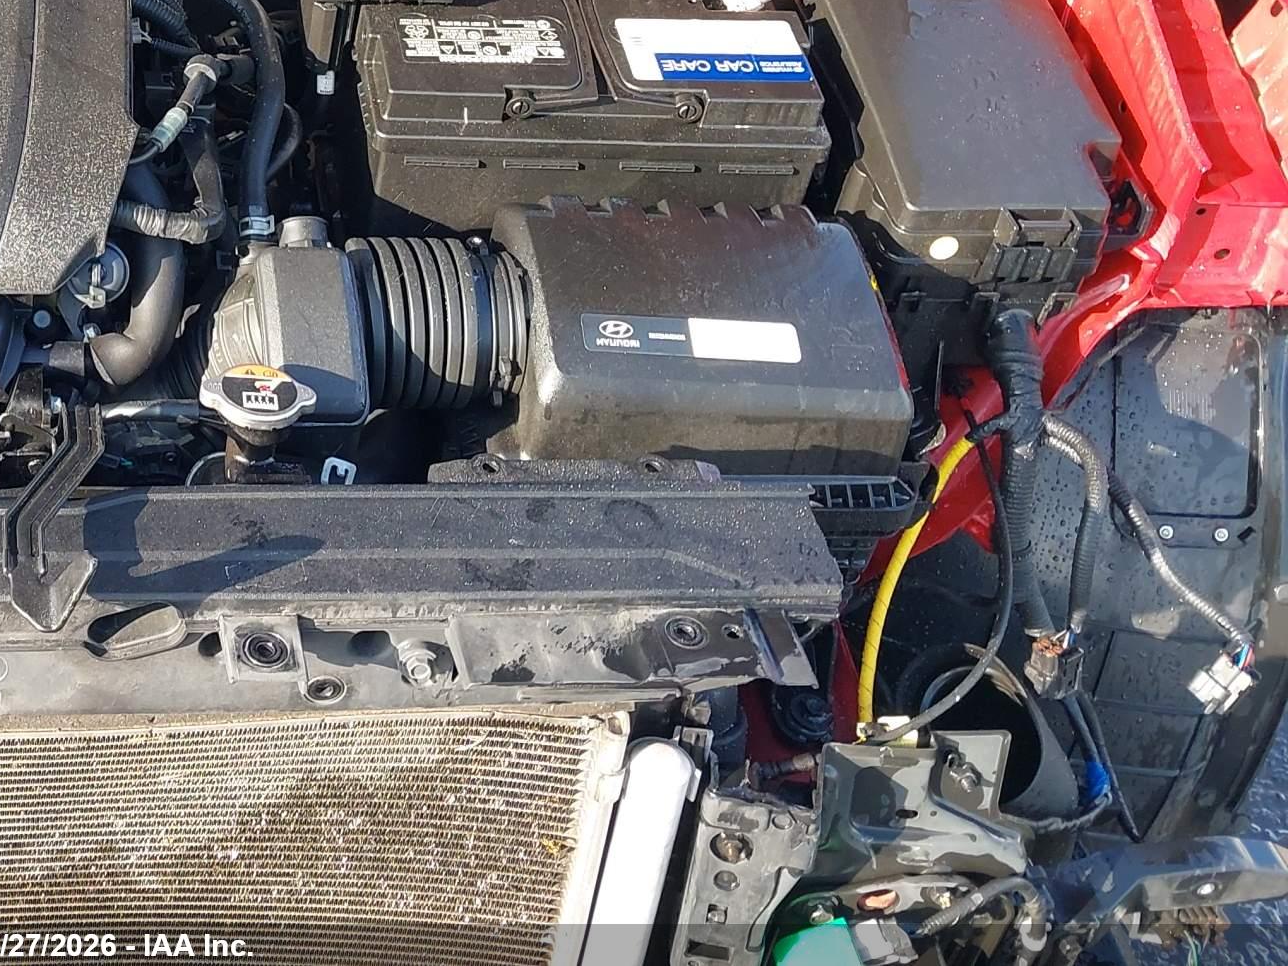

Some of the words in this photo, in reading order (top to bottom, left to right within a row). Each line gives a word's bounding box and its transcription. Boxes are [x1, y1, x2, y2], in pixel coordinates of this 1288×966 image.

[661, 59, 711, 72] CARE
[714, 60, 753, 73] CAR
[596, 338, 641, 348] HYUNDAI
